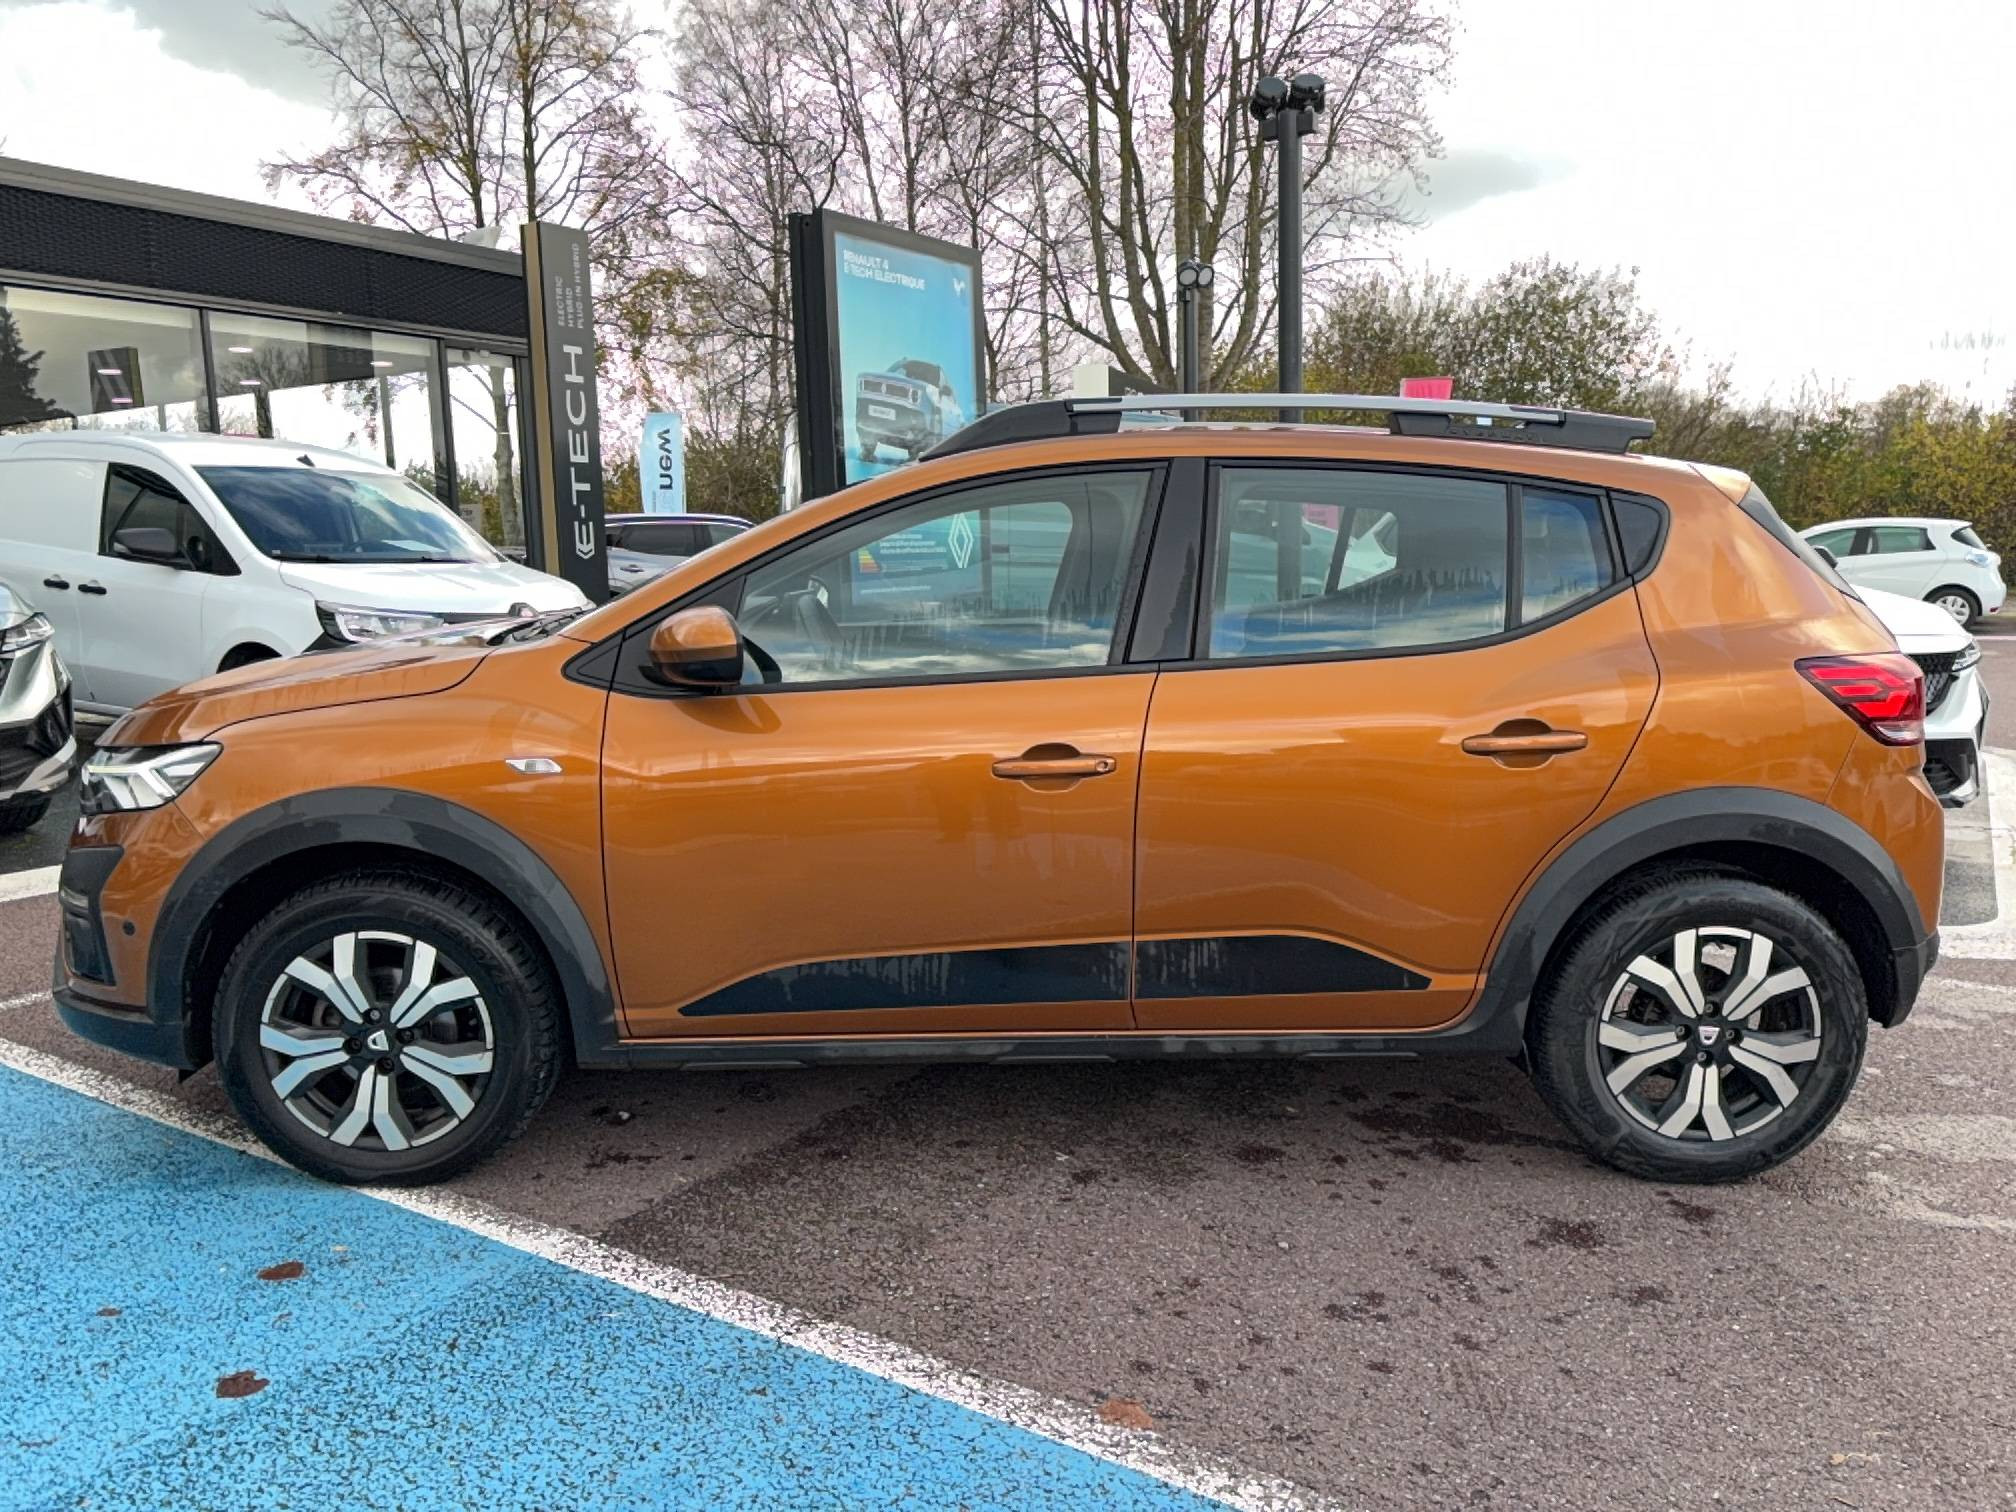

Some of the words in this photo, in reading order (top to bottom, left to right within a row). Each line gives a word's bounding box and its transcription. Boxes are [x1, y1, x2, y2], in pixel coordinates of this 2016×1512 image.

[572, 243, 581, 283] HYBRID
[555, 275, 565, 327] ELECTRIC
[565, 287, 574, 327] HYBRID
[562, 344, 596, 560] E-TECH
